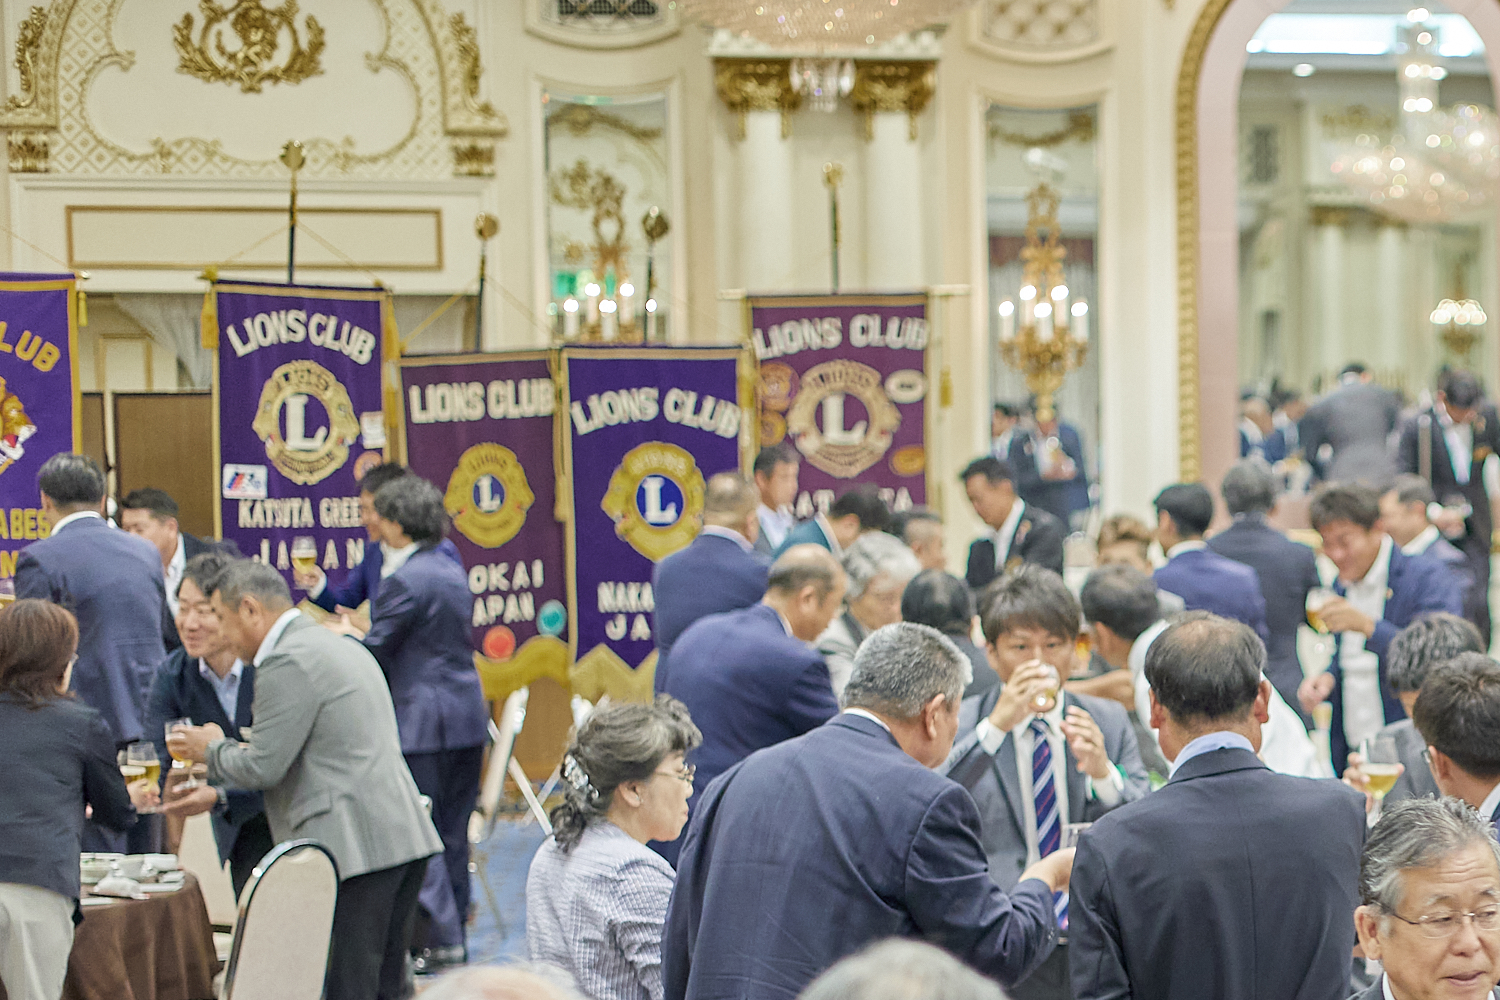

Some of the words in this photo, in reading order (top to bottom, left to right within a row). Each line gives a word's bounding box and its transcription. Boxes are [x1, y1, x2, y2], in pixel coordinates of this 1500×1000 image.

[0, 321, 60, 372] LUB
[226, 309, 308, 358] LIONS
[308, 312, 376, 365] CLUB
[753, 316, 842, 360] LIONS
[850, 313, 929, 350] CLUB
[285, 394, 329, 450] L
[409, 381, 485, 424] LIONS
[487, 377, 555, 419] CLUB
[571, 386, 659, 436] LIONS
[663, 387, 742, 439] CLUB
[821, 394, 868, 446] L
[238, 497, 315, 528] KATSUTA
[319, 497, 363, 528] GREE
[475, 474, 502, 512] L
[641, 476, 678, 524] L
[783, 485, 914, 519] ATTA
[252, 537, 365, 571] JAAN
[468, 558, 545, 594] OKAI
[472, 591, 536, 627] APAN
